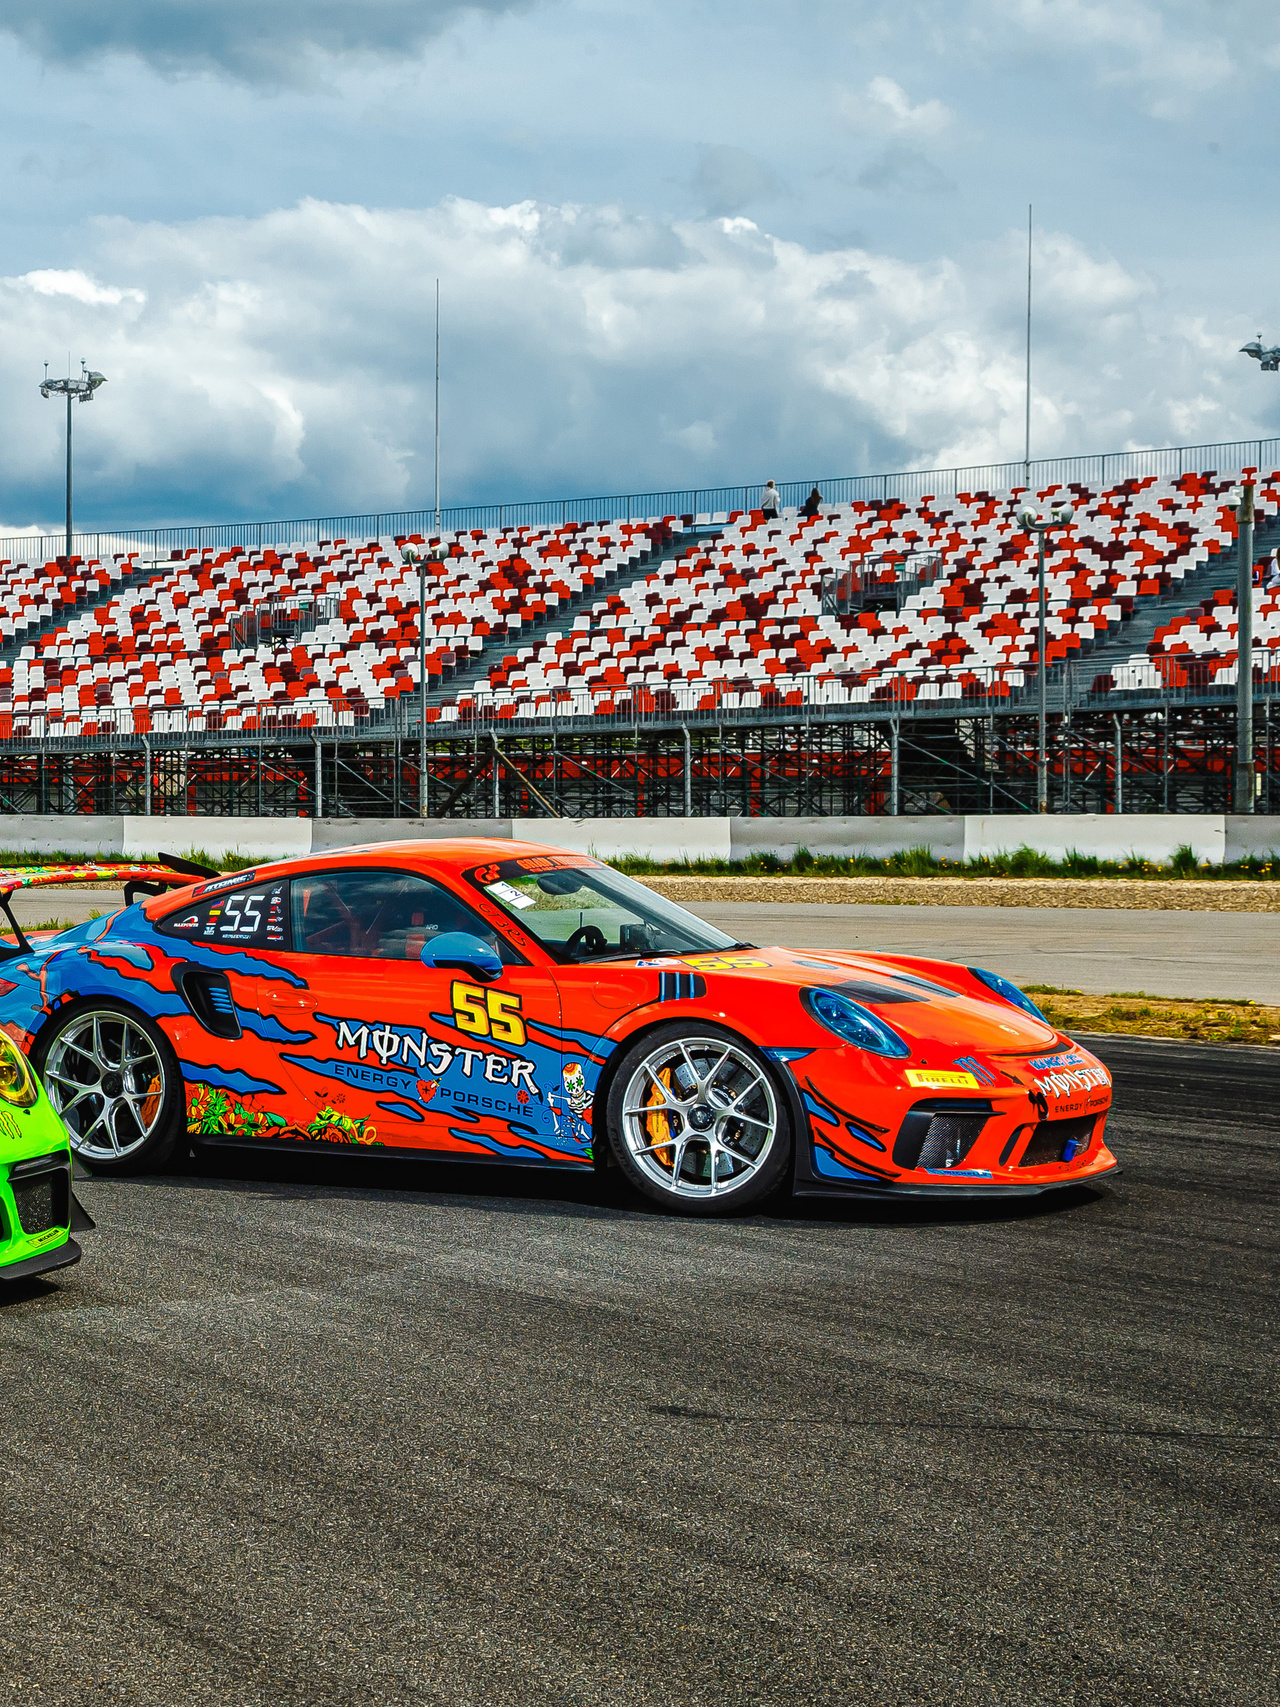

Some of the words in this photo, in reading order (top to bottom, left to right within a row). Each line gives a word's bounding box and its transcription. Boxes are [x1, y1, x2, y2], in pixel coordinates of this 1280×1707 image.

[220, 895, 265, 932] 55
[479, 904, 530, 947] GT3RS
[680, 957, 772, 970] 55
[451, 981, 527, 1046] 55
[334, 1064, 412, 1090] ENERGY
[440, 1089, 534, 1117] PORSCHE
[916, 1073, 969, 1084] PIRELLI
[1055, 1102, 1083, 1113] ENERGY
[38, 1230, 59, 1243] MICHELIN
